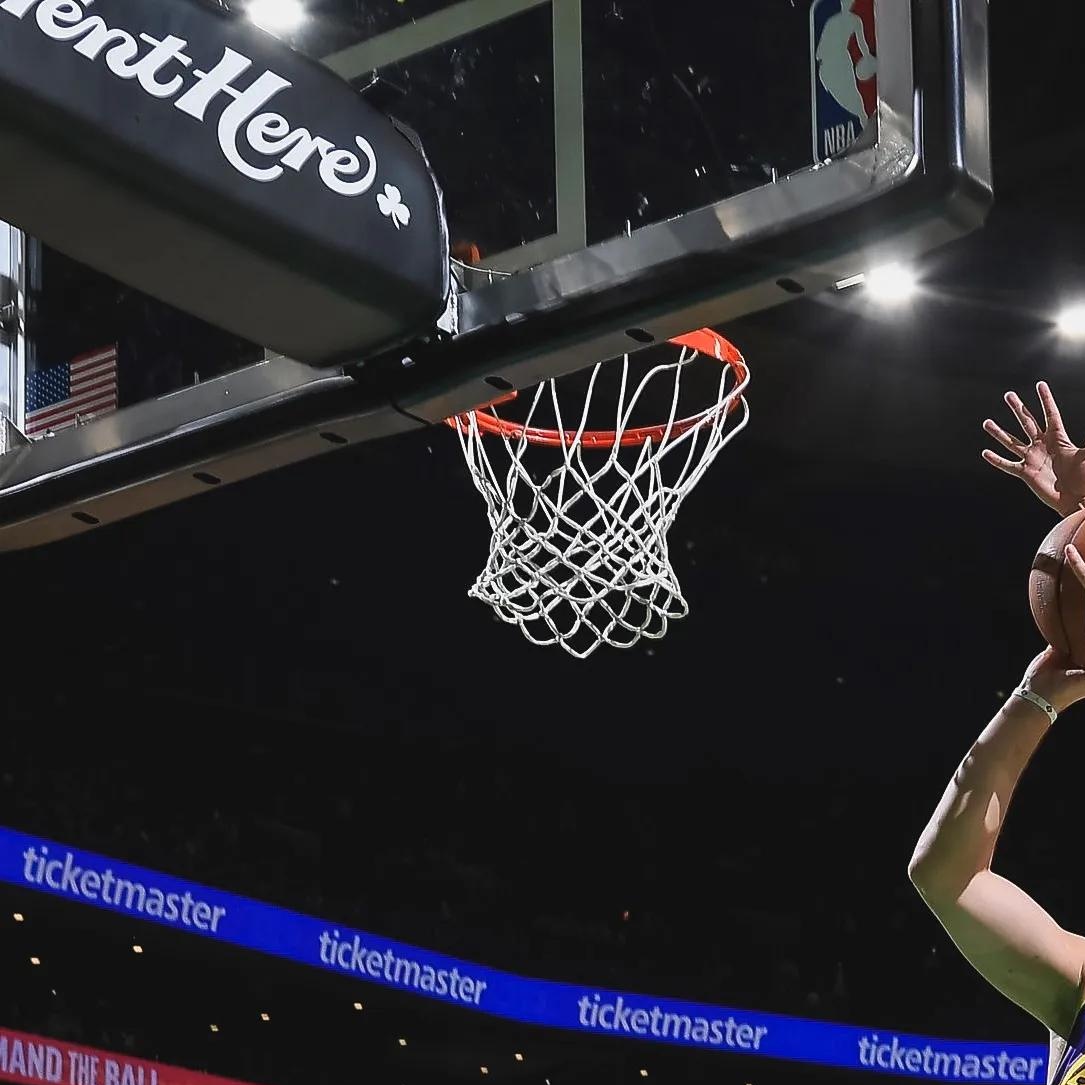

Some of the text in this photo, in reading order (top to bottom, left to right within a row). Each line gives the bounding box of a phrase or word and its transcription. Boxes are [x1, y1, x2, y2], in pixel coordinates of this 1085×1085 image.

[22, 845, 227, 933] ticketmaster
[319, 929, 488, 1006] ticketmaster
[577, 993, 768, 1050] ticketmaster
[857, 1033, 1044, 1082] ticketmaster
